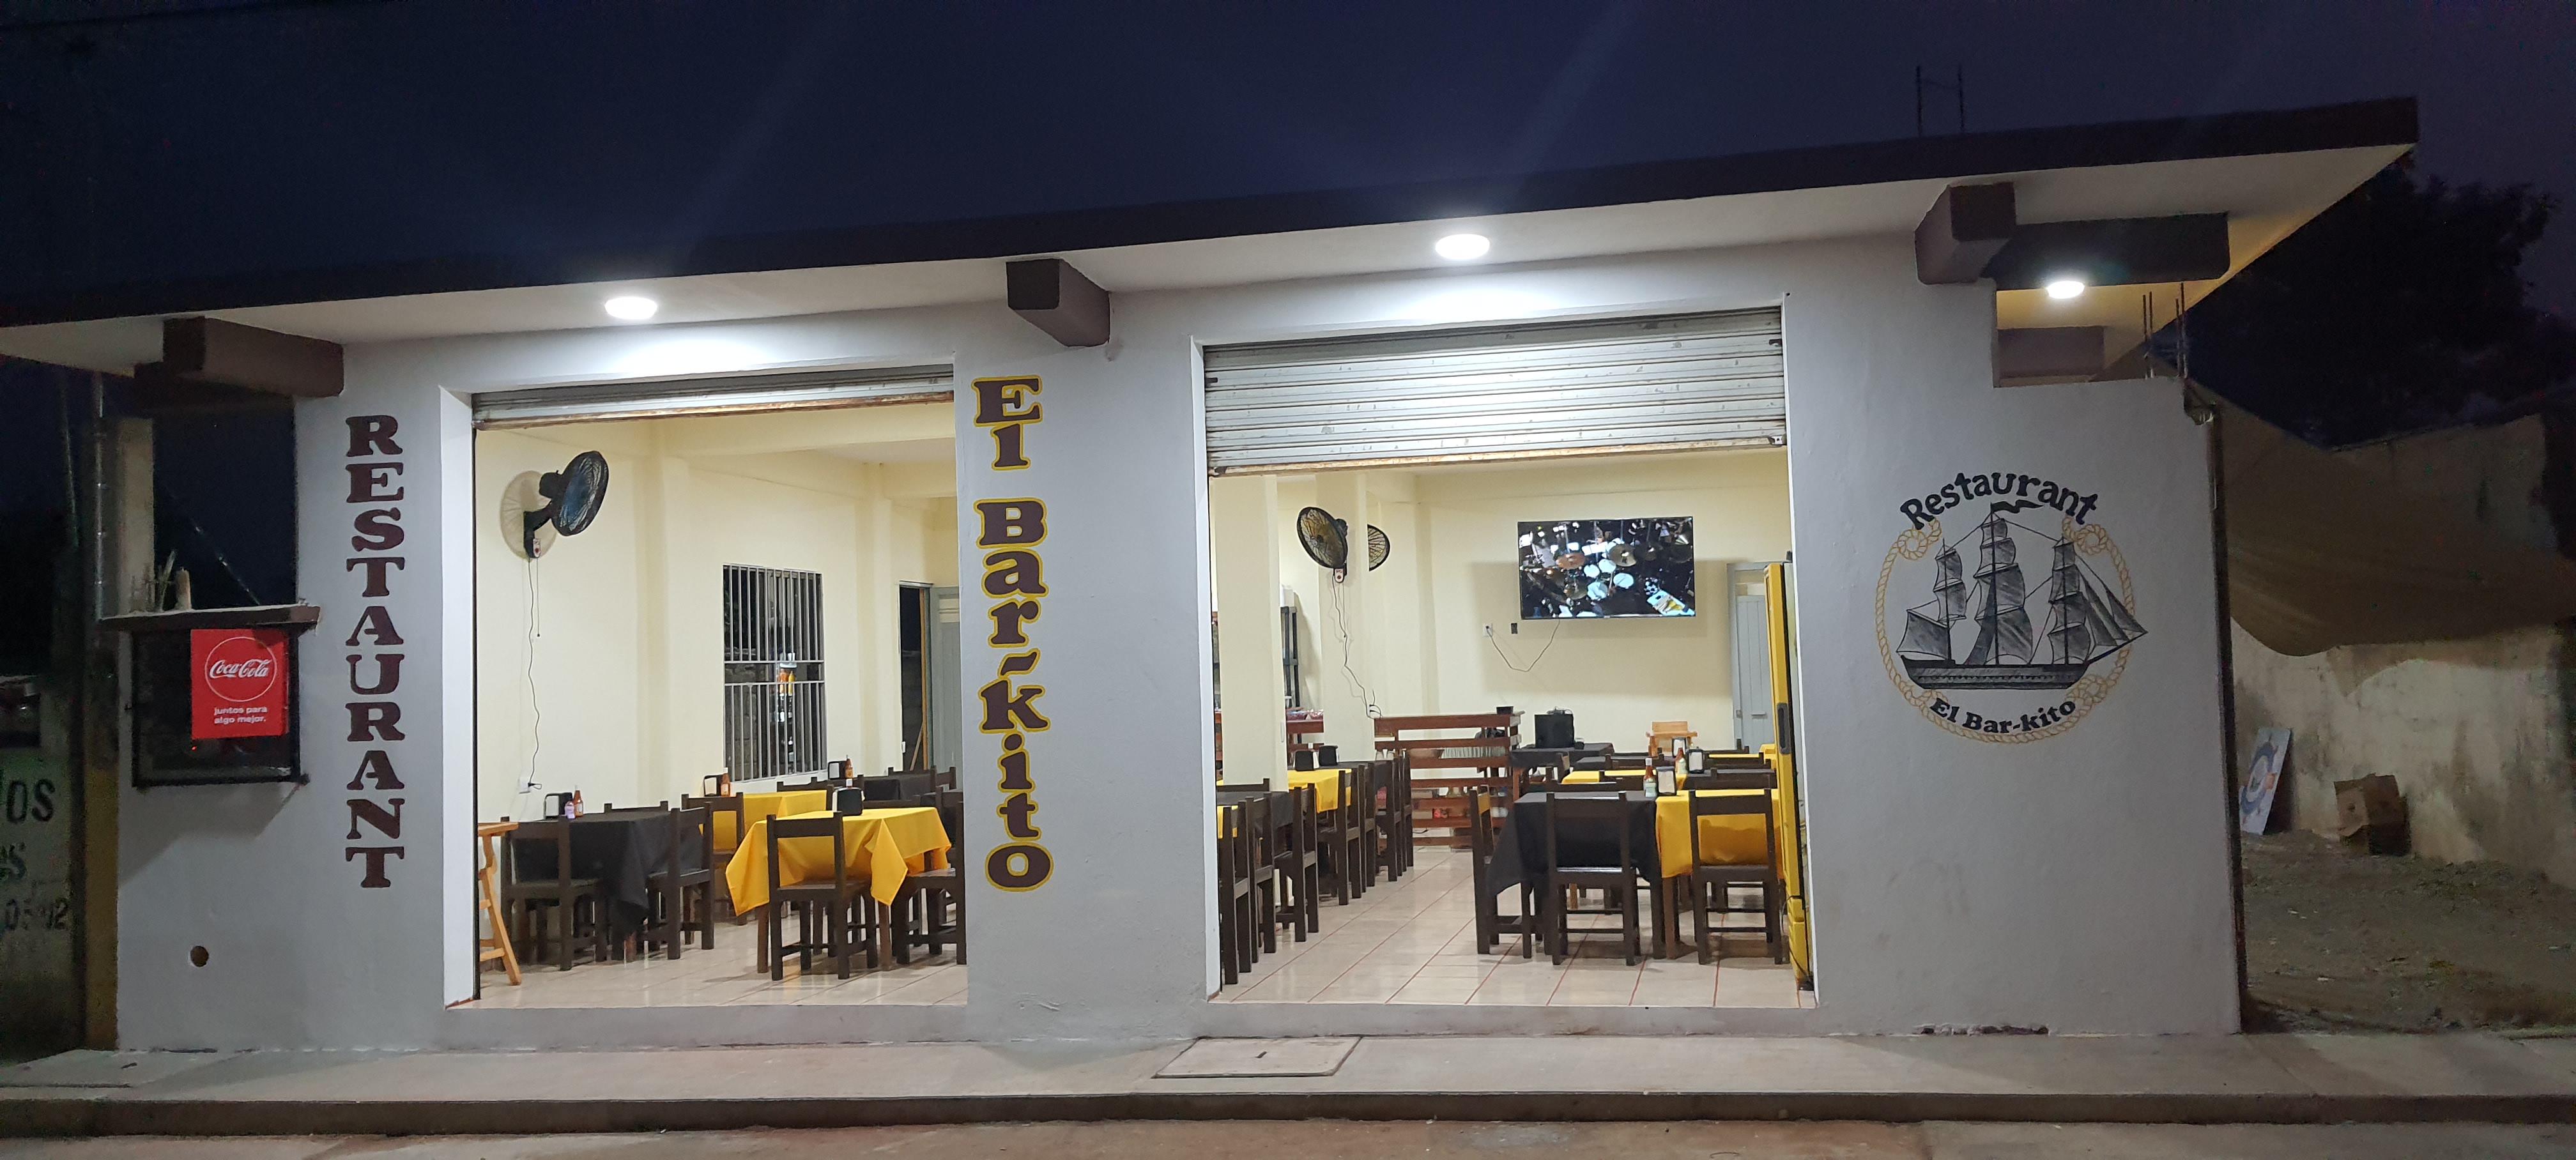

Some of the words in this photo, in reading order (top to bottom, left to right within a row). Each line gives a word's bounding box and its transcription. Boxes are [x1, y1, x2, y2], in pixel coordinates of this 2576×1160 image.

[970, 374, 1043, 471] El
[1899, 471, 2099, 530] Restaurant
[345, 414, 406, 889] RESTAURANT
[213, 706, 244, 716] juntos
[246, 706, 268, 714] para
[213, 716, 236, 725] algo
[1929, 698, 1960, 723] El
[1962, 701, 2076, 734] Bar-kito
